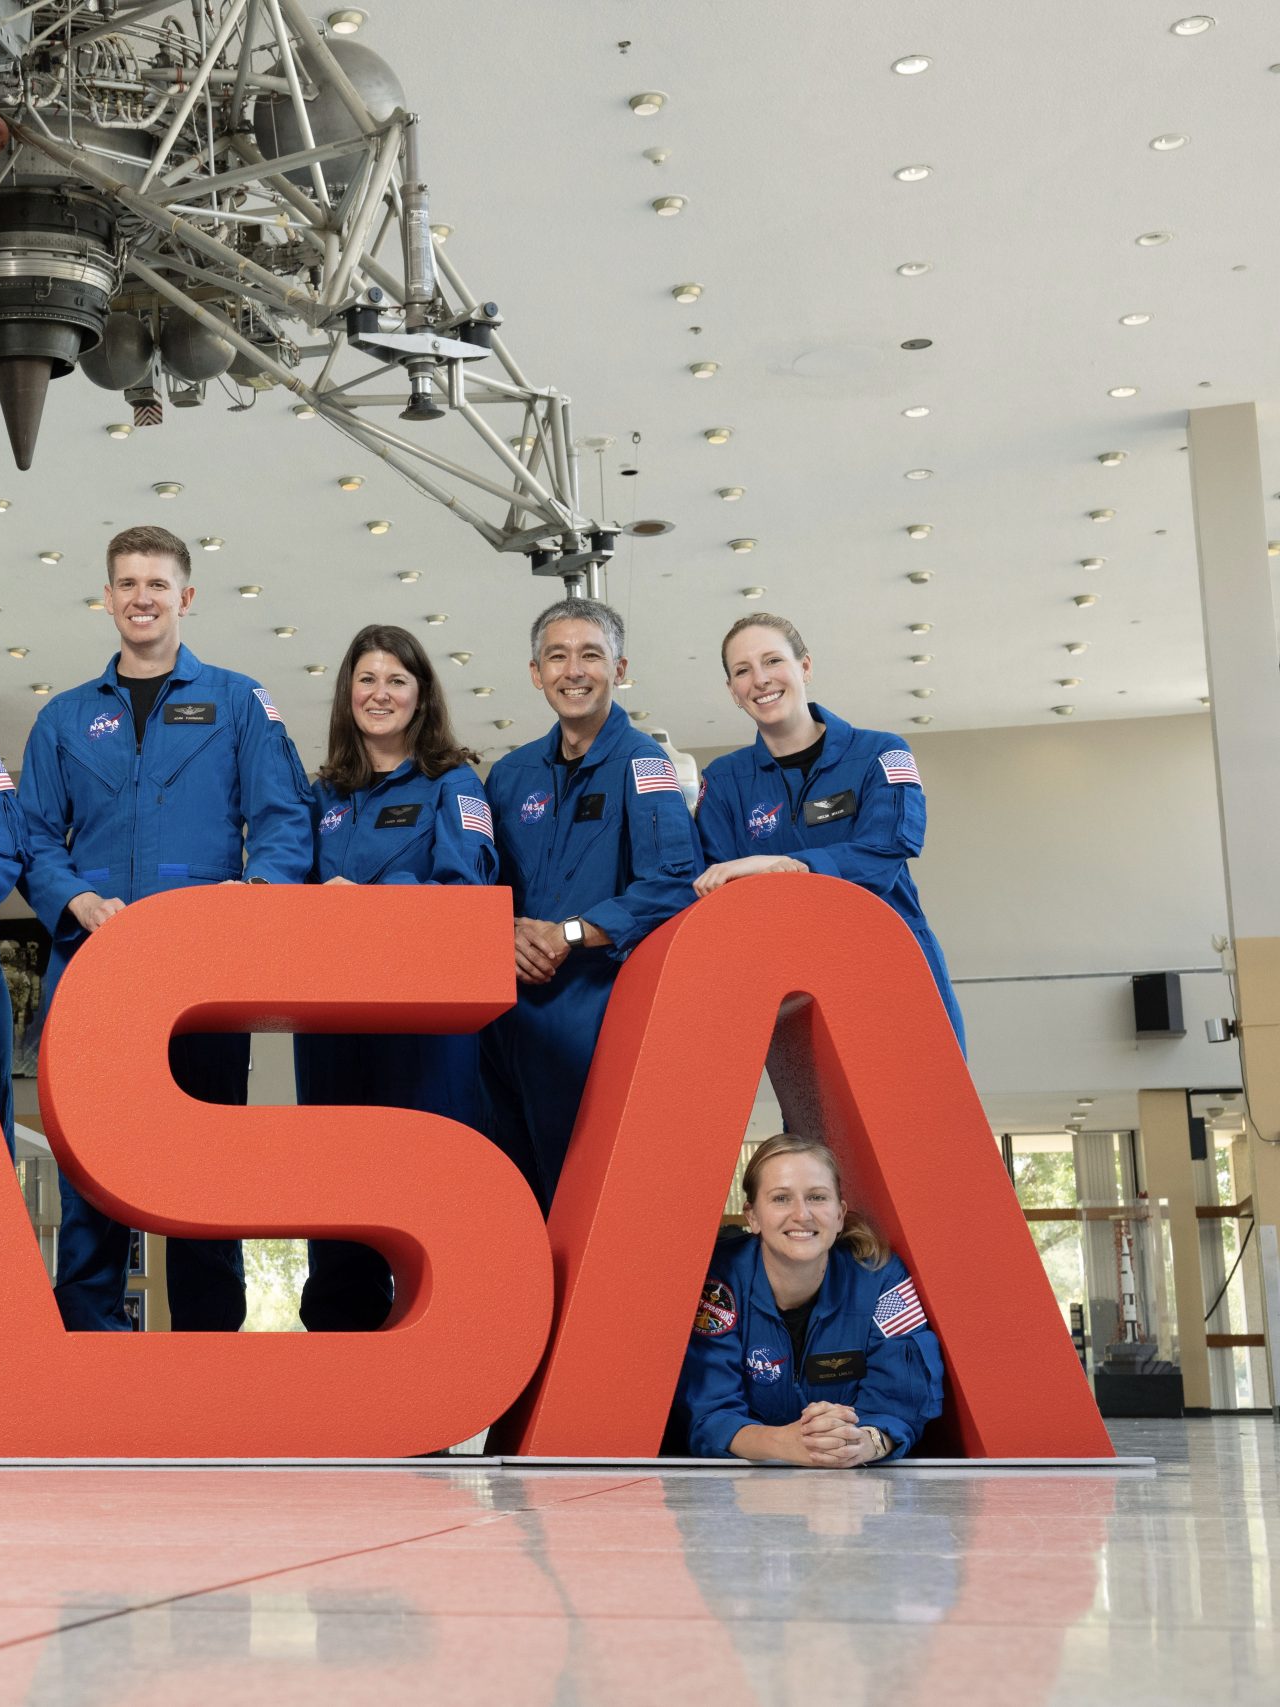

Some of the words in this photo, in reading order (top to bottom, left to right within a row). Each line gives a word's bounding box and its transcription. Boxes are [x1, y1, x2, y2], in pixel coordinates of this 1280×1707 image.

[90, 719, 119, 731] NASA
[521, 803, 544, 811] NASA
[749, 814, 776, 827] NASA
[746, 1357, 781, 1373] NASA
